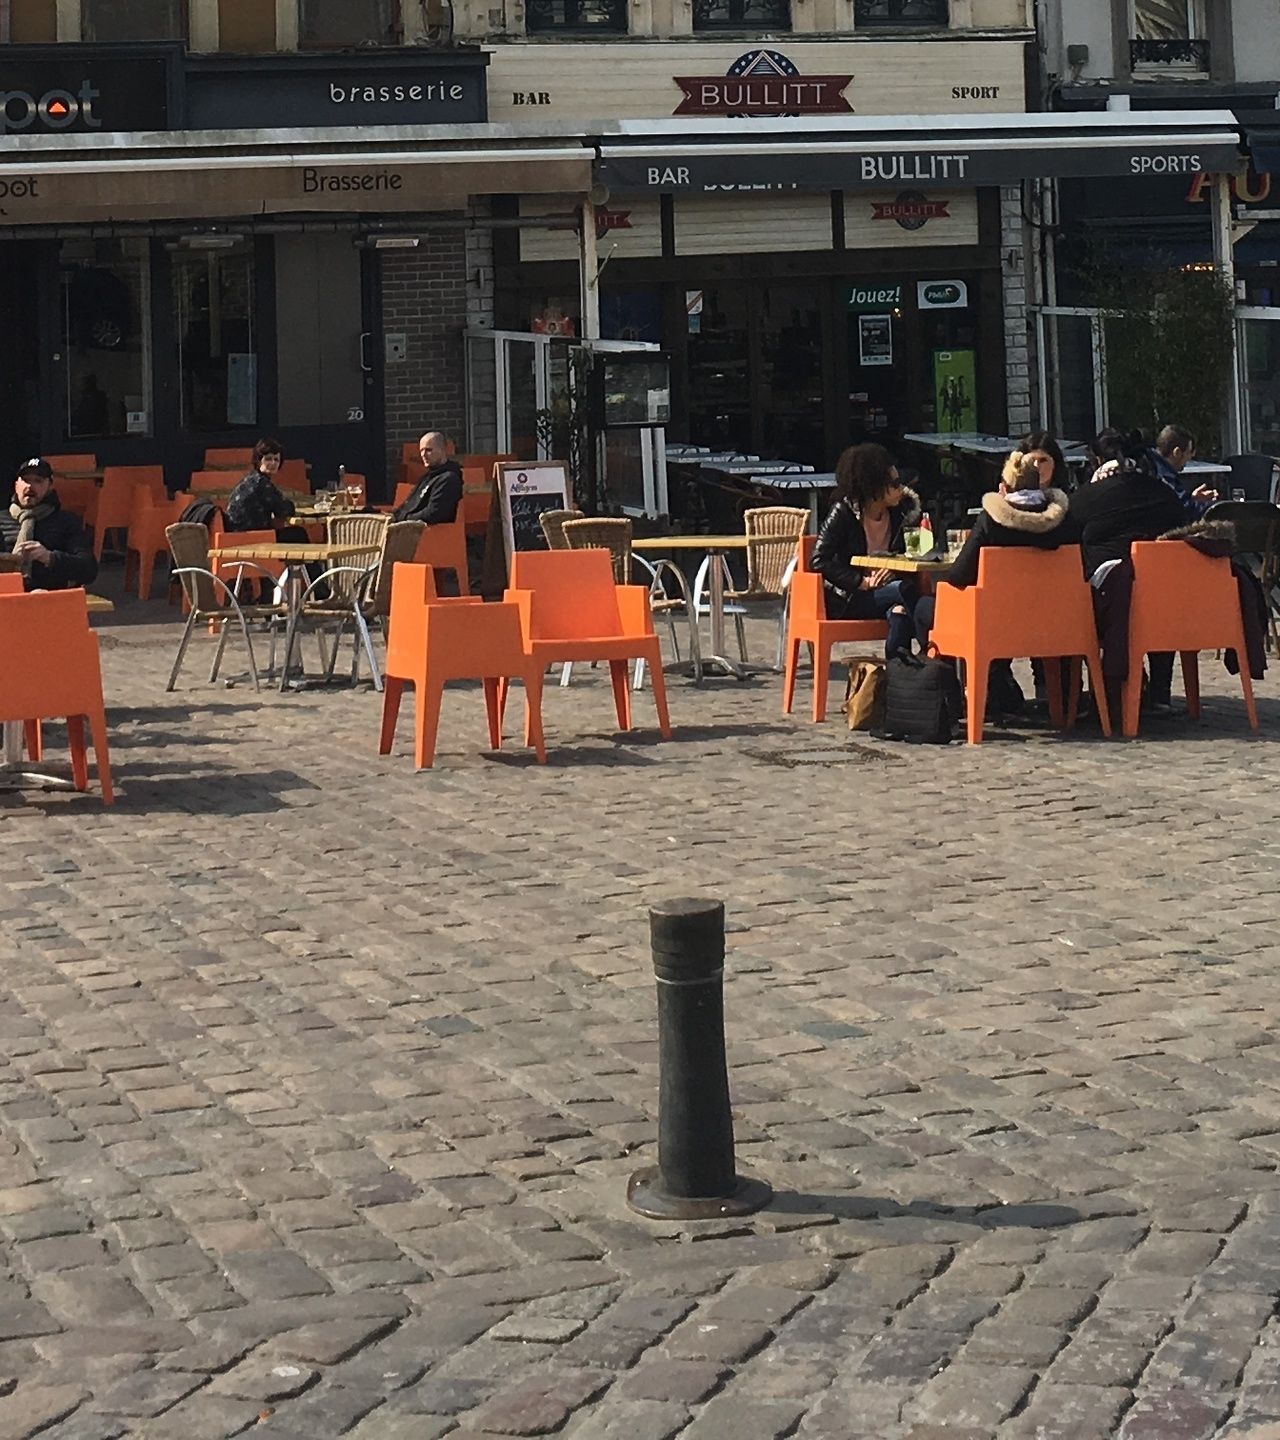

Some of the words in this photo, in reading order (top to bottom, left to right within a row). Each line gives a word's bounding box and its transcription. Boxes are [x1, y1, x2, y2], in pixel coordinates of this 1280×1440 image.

[330, 80, 464, 104] brasserie
[512, 91, 551, 106] BAR
[701, 83, 827, 106] BULLITT
[951, 86, 1000, 100] SPORT
[860, 155, 969, 180] BULLITT
[1130, 155, 1202, 174] SPORTS
[303, 168, 402, 193] Brasserie
[648, 167, 690, 185] BAR
[883, 204, 938, 217] BULLITT
[849, 286, 901, 304] Jouez!
[346, 408, 364, 421] 20
